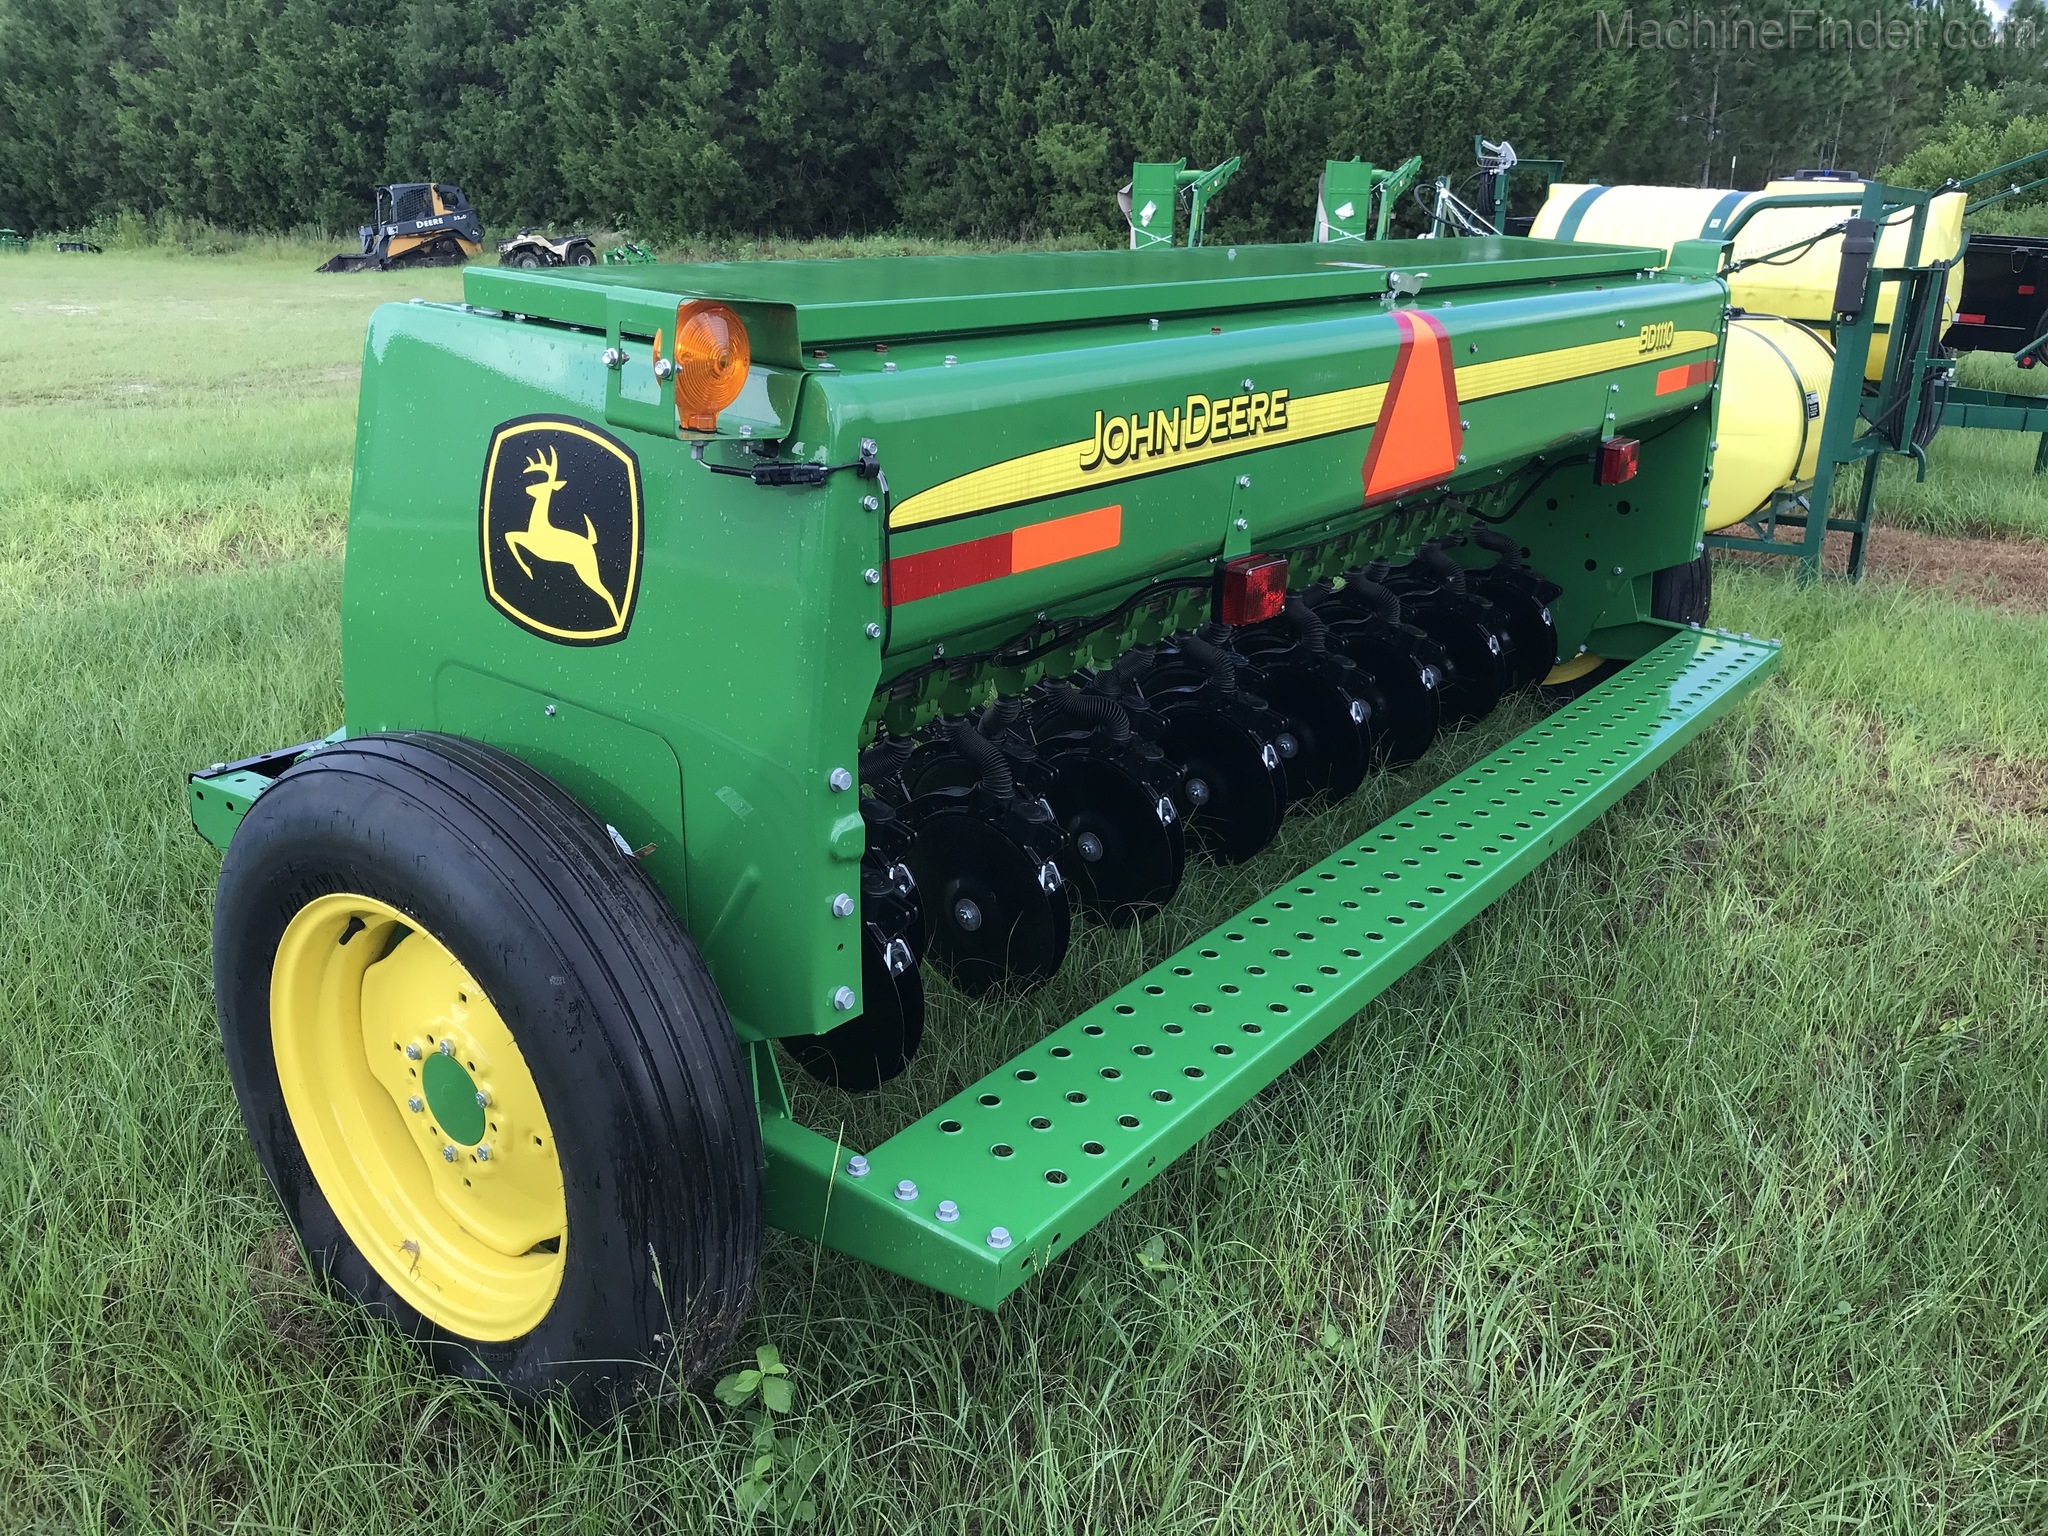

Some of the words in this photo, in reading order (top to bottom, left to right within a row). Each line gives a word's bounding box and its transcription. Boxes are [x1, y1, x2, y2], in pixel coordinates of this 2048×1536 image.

[416, 217, 444, 229] DEERE
[1639, 320, 1674, 353] BD1110
[1080, 405, 1182, 471] JOHN
[1184, 388, 1290, 449] DEERE
